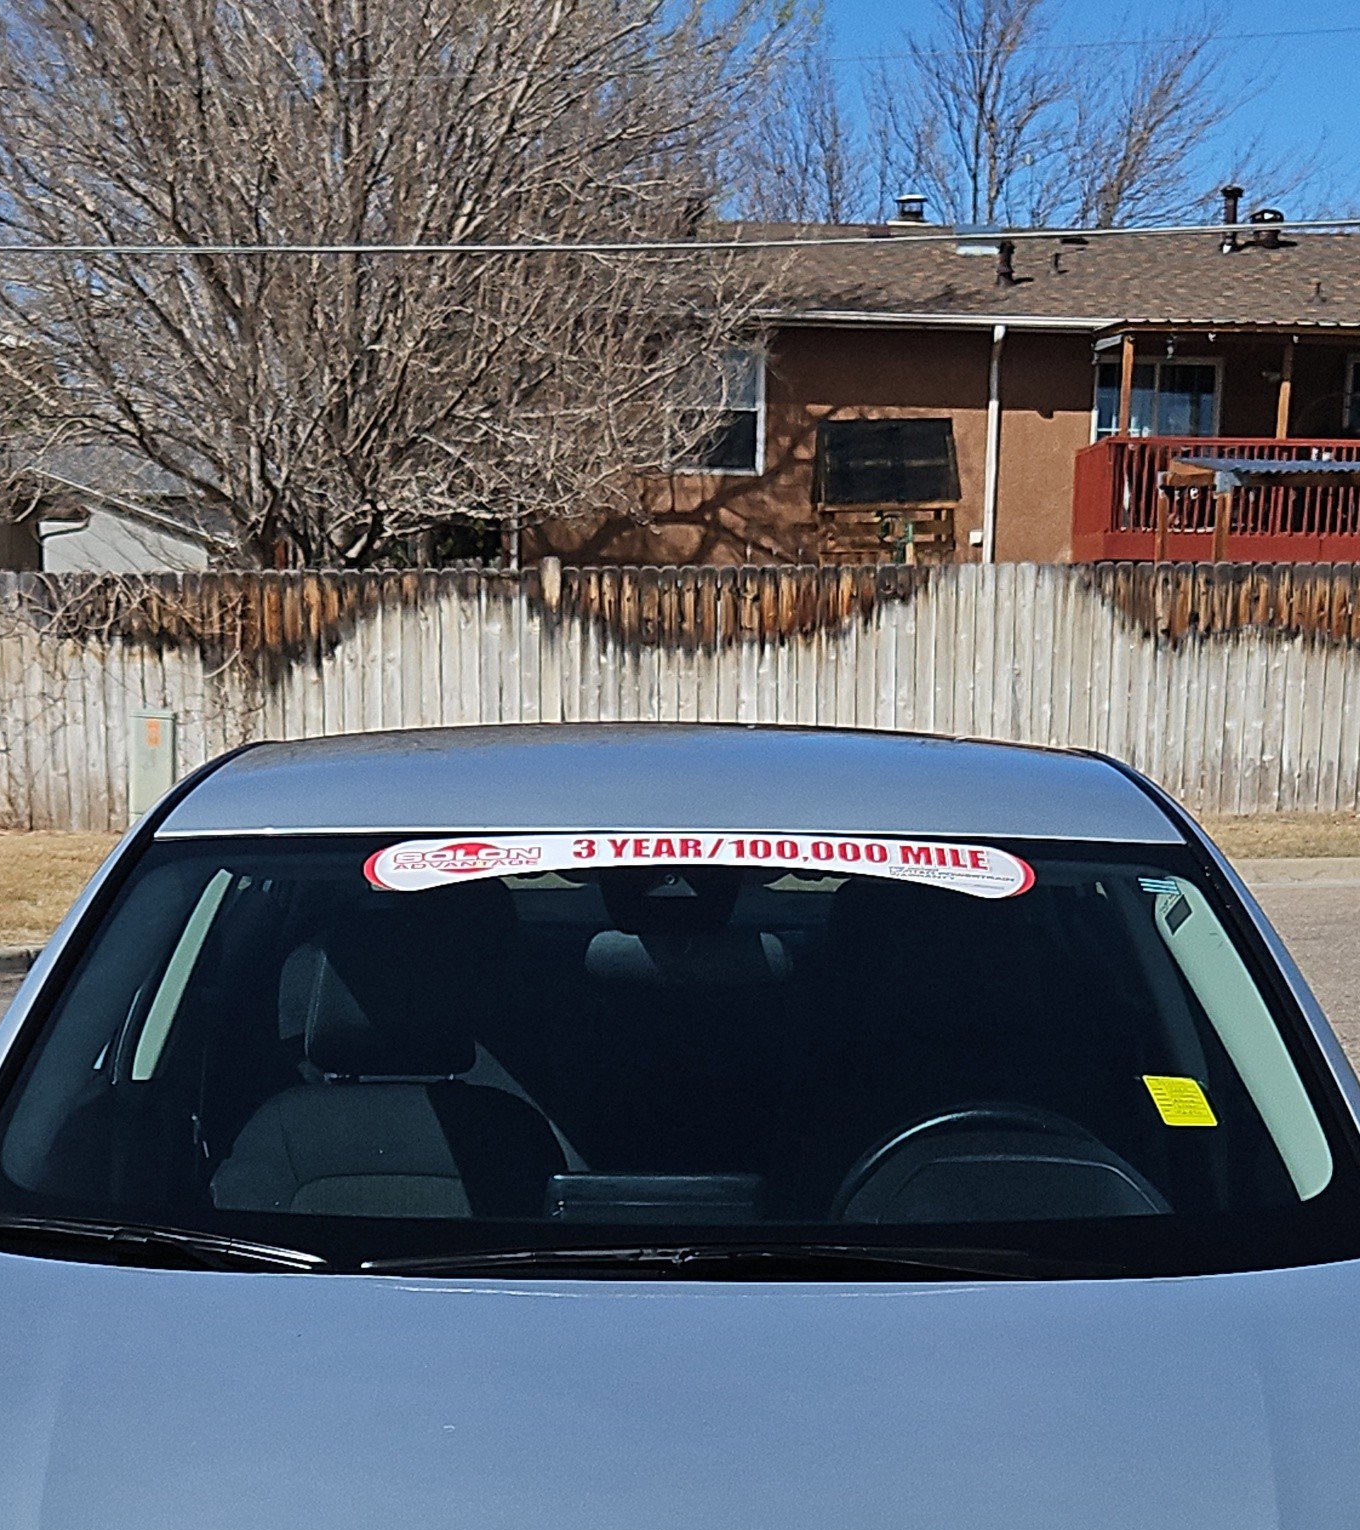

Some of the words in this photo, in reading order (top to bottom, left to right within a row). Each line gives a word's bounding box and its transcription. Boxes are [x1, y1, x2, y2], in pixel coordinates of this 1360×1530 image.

[393, 846, 542, 865] SOLON
[572, 838, 596, 859] 3
[607, 838, 889, 863] YEAR/100,000
[899, 845, 989, 870] MILE
[393, 858, 538, 871] ADVANTAGE
